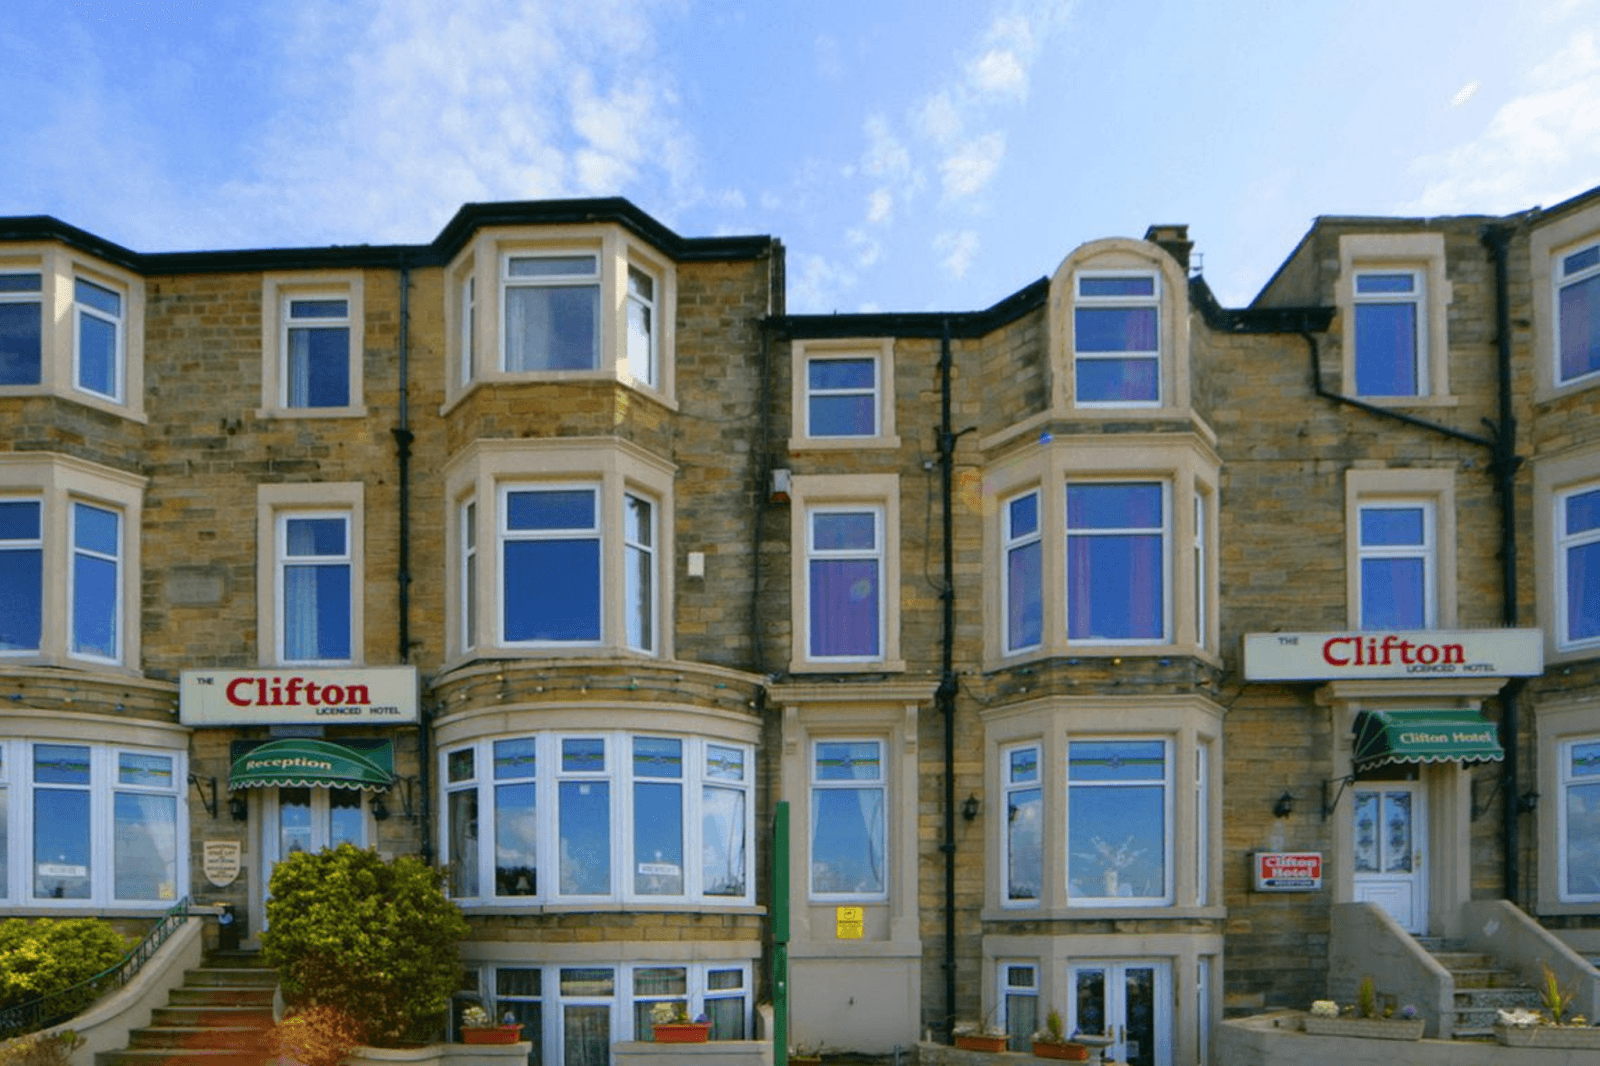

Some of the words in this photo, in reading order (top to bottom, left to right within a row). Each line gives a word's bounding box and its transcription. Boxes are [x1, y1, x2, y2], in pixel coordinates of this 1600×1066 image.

[1278, 637, 1299, 645] THE
[1322, 635, 1466, 667] Clifton
[1406, 665, 1456, 673] LICENCED
[1463, 664, 1496, 672] HOTEL
[197, 677, 214, 685] THE
[226, 677, 371, 706] Clifton
[316, 707, 362, 716] LICENCED
[369, 706, 400, 715] HOTEL
[1400, 732, 1448, 743] Clifton
[1453, 731, 1492, 743] Hotel
[246, 757, 332, 770] Reception
[1264, 855, 1317, 867] Clifton
[1271, 866, 1312, 878] Hotel
